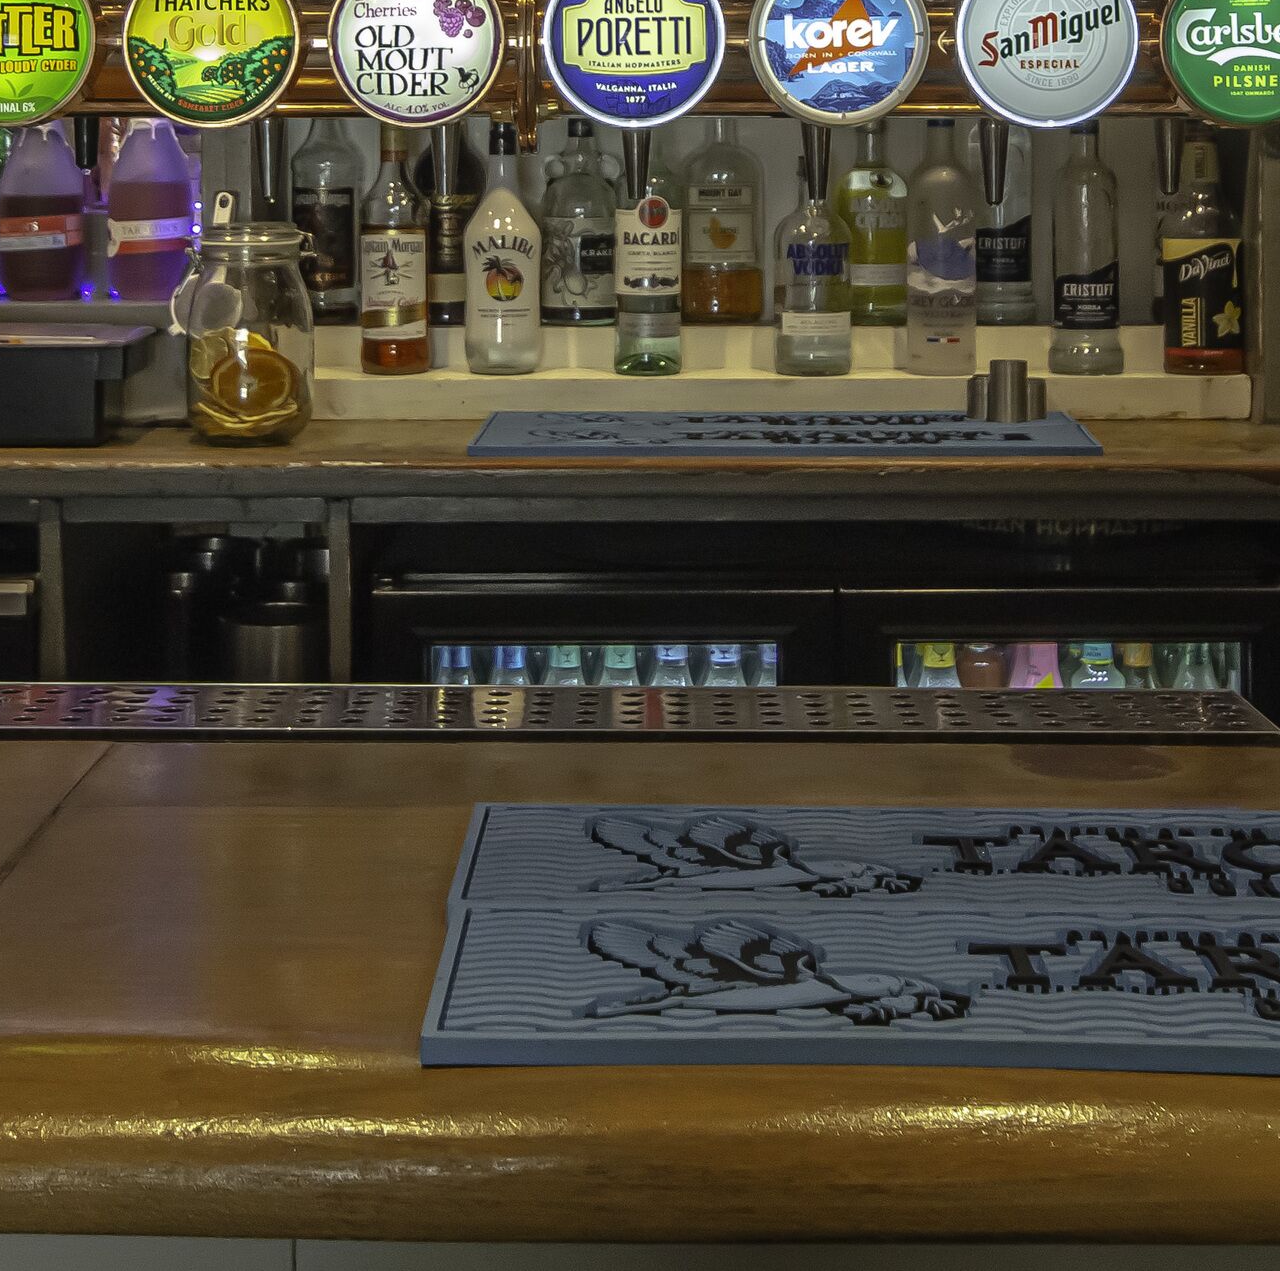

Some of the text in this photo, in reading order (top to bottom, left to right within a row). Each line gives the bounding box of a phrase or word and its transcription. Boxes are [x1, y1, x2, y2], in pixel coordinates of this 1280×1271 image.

[353, 2, 417, 19] Cherries
[168, 13, 247, 52] Gold
[354, 24, 415, 48] OLD
[576, 16, 692, 57] PORETTI
[783, 12, 900, 49] korev
[354, 47, 454, 71] MOUT
[785, 49, 898, 60] BORN IN CORNWALL
[40, 59, 78, 72] CYDER
[588, 58, 681, 69] ITALIAN HOPMASTERS
[806, 60, 875, 74] LAGER
[1020, 59, 1080, 69] ESPECIAL
[1233, 64, 1271, 73] DANISH
[356, 71, 451, 97] CIDER
[648, 81, 678, 92] ITALIA
[1024, 71, 1054, 88] SINCE
[626, 95, 646, 103] 1877
[22, 102, 36, 113] 6%
[405, 102, 429, 114] 4.0%
[623, 230, 680, 246] BACARDI
[471, 233, 535, 260] MALIBU
[581, 247, 615, 257] KRAKE
[1063, 282, 1115, 297] ERISTOFF
[1181, 296, 1197, 347] VANILLA
